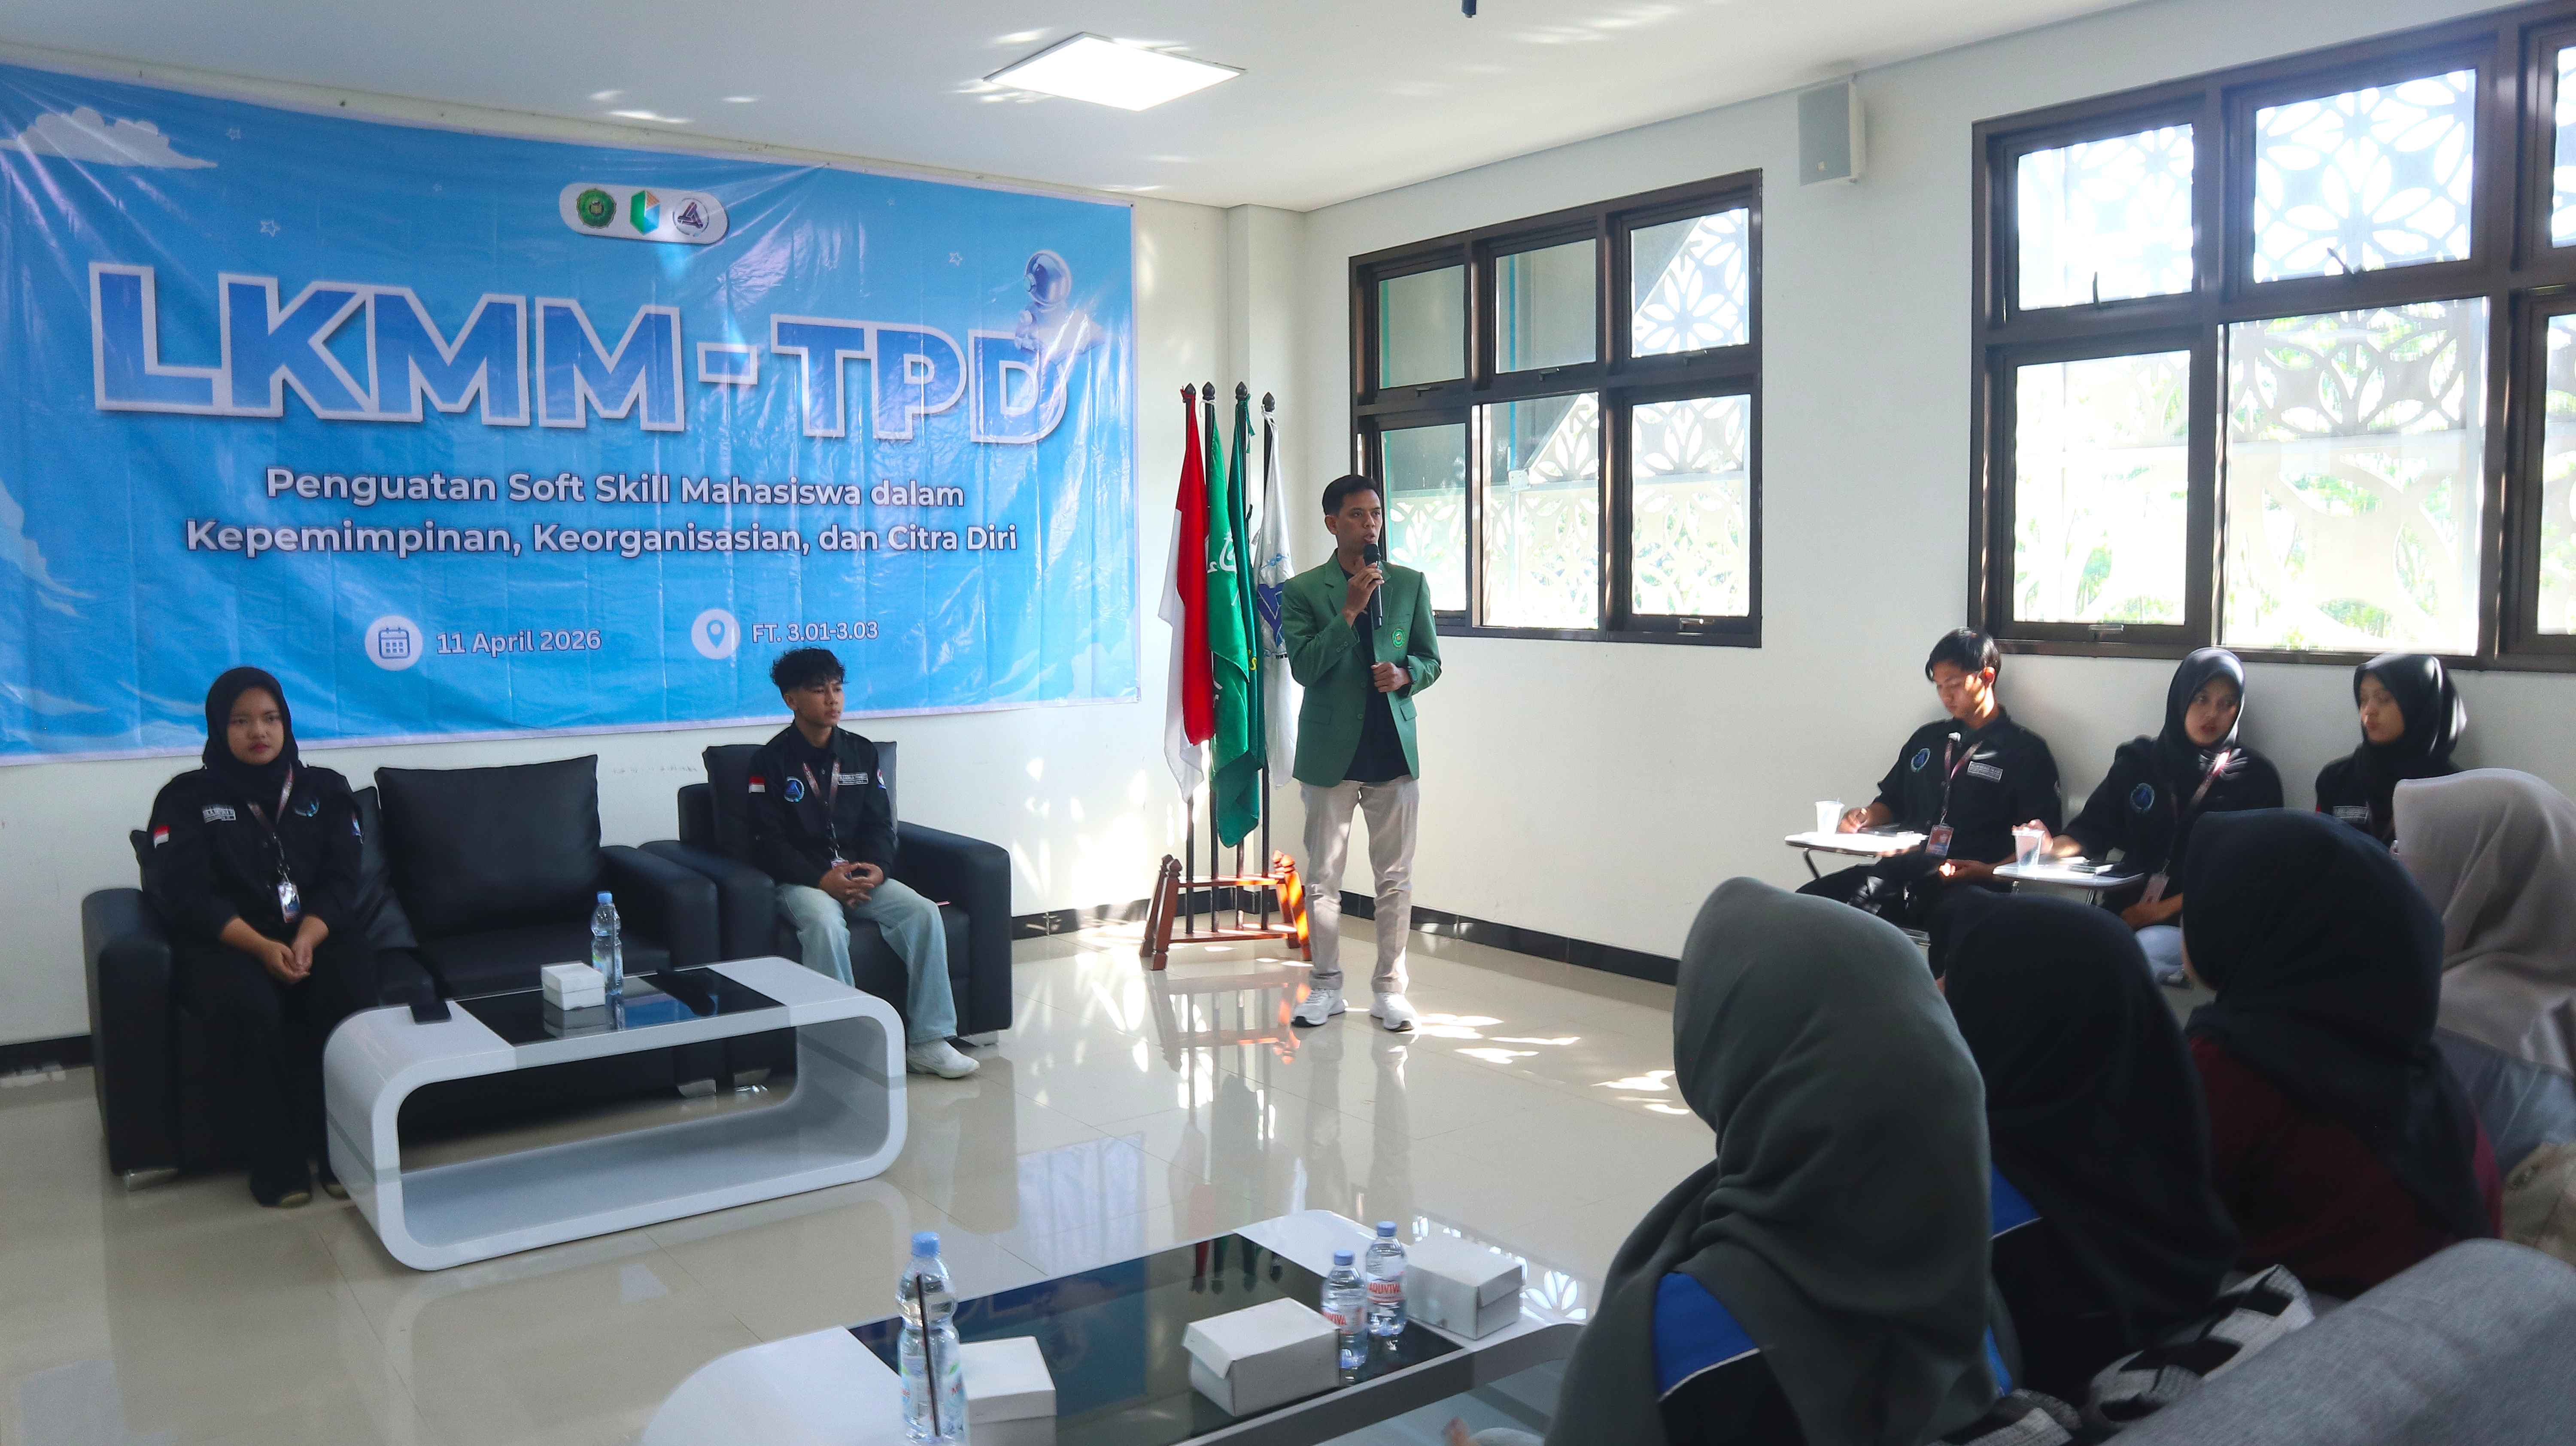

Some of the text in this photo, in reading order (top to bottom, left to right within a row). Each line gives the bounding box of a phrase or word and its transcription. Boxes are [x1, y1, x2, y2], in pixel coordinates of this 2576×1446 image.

[89, 261, 1068, 445] LKMM-TPD
[267, 467, 964, 507] Penguatan Soft Skill Mahasiswa dalam
[186, 519, 1017, 559] Kepemimpinan, Keorganisasian, dan Citra Diri
[436, 629, 601, 658] 11 April 2026
[752, 621, 879, 643] FT. 3.01-3.03
